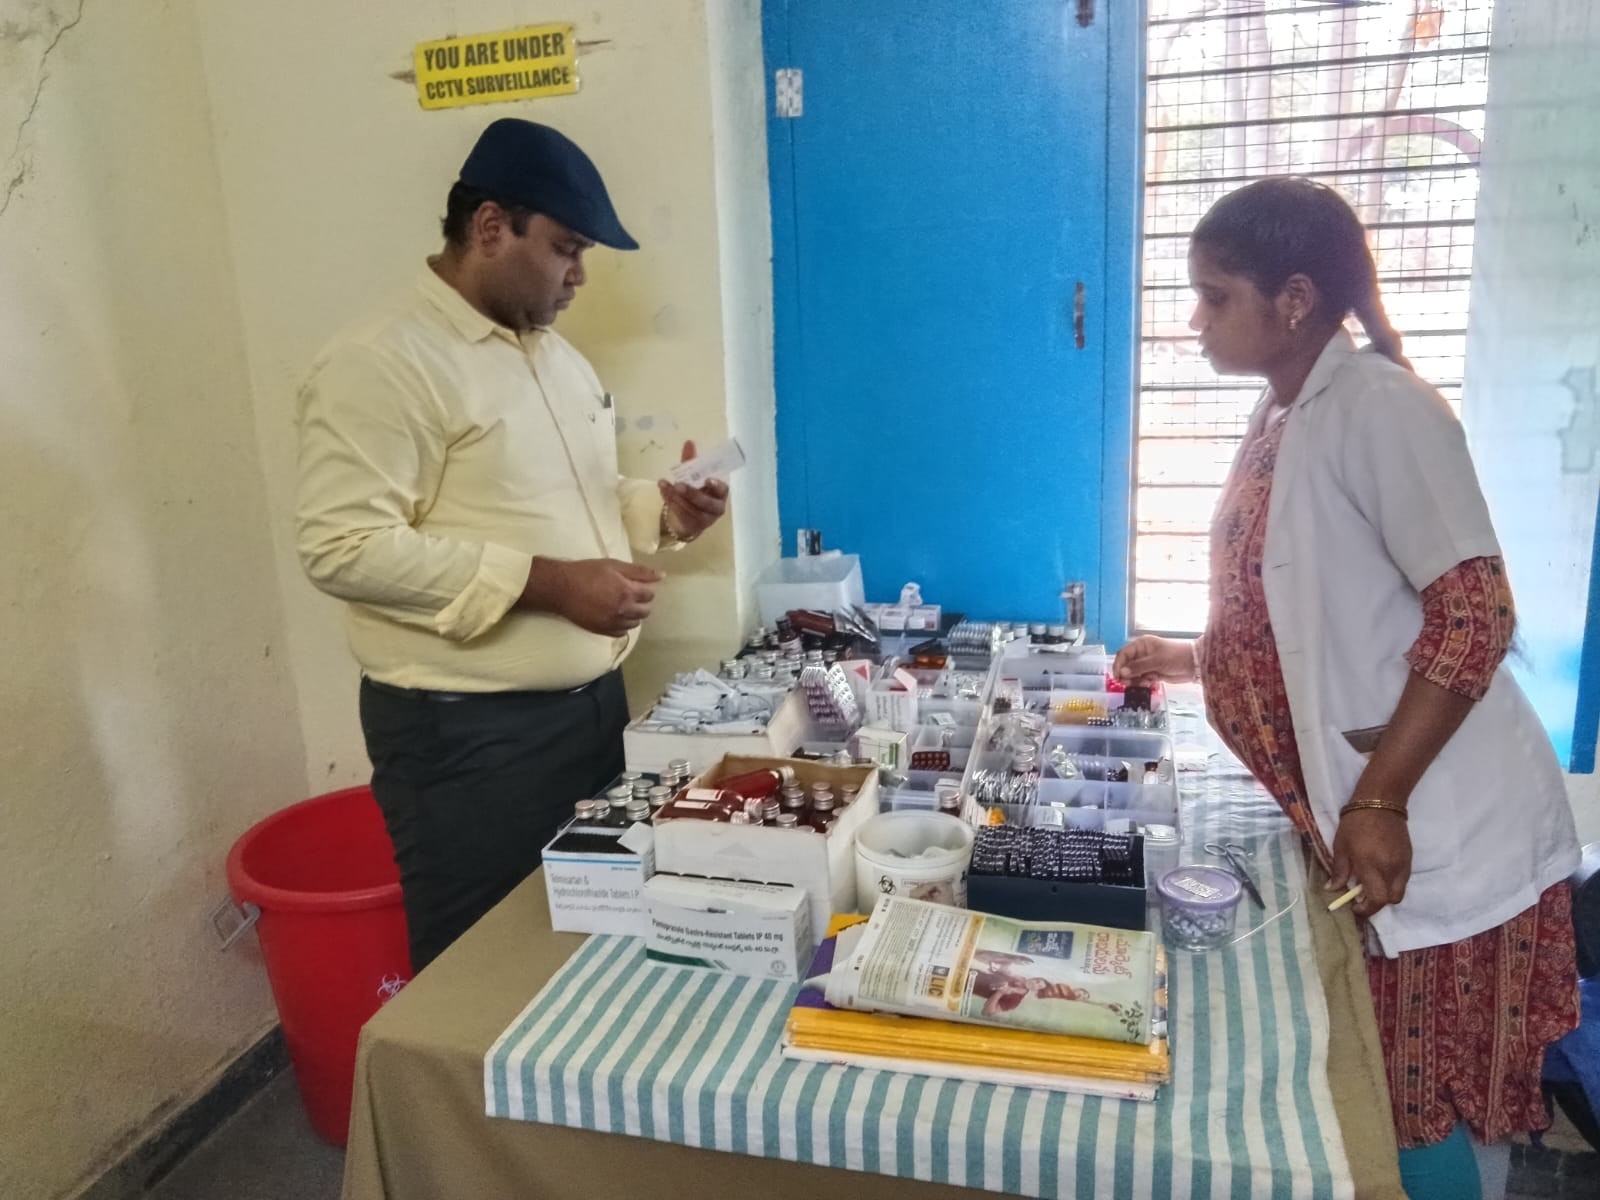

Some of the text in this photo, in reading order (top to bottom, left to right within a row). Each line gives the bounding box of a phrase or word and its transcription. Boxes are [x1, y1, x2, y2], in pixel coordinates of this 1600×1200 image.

[424, 32, 565, 71] YOU ARE UNDER
[425, 67, 570, 100] CCTV SURVEILLANCE
[733, 931, 755, 941] Tablets
[773, 933, 783, 942] mg
[929, 977, 946, 997] LIC
